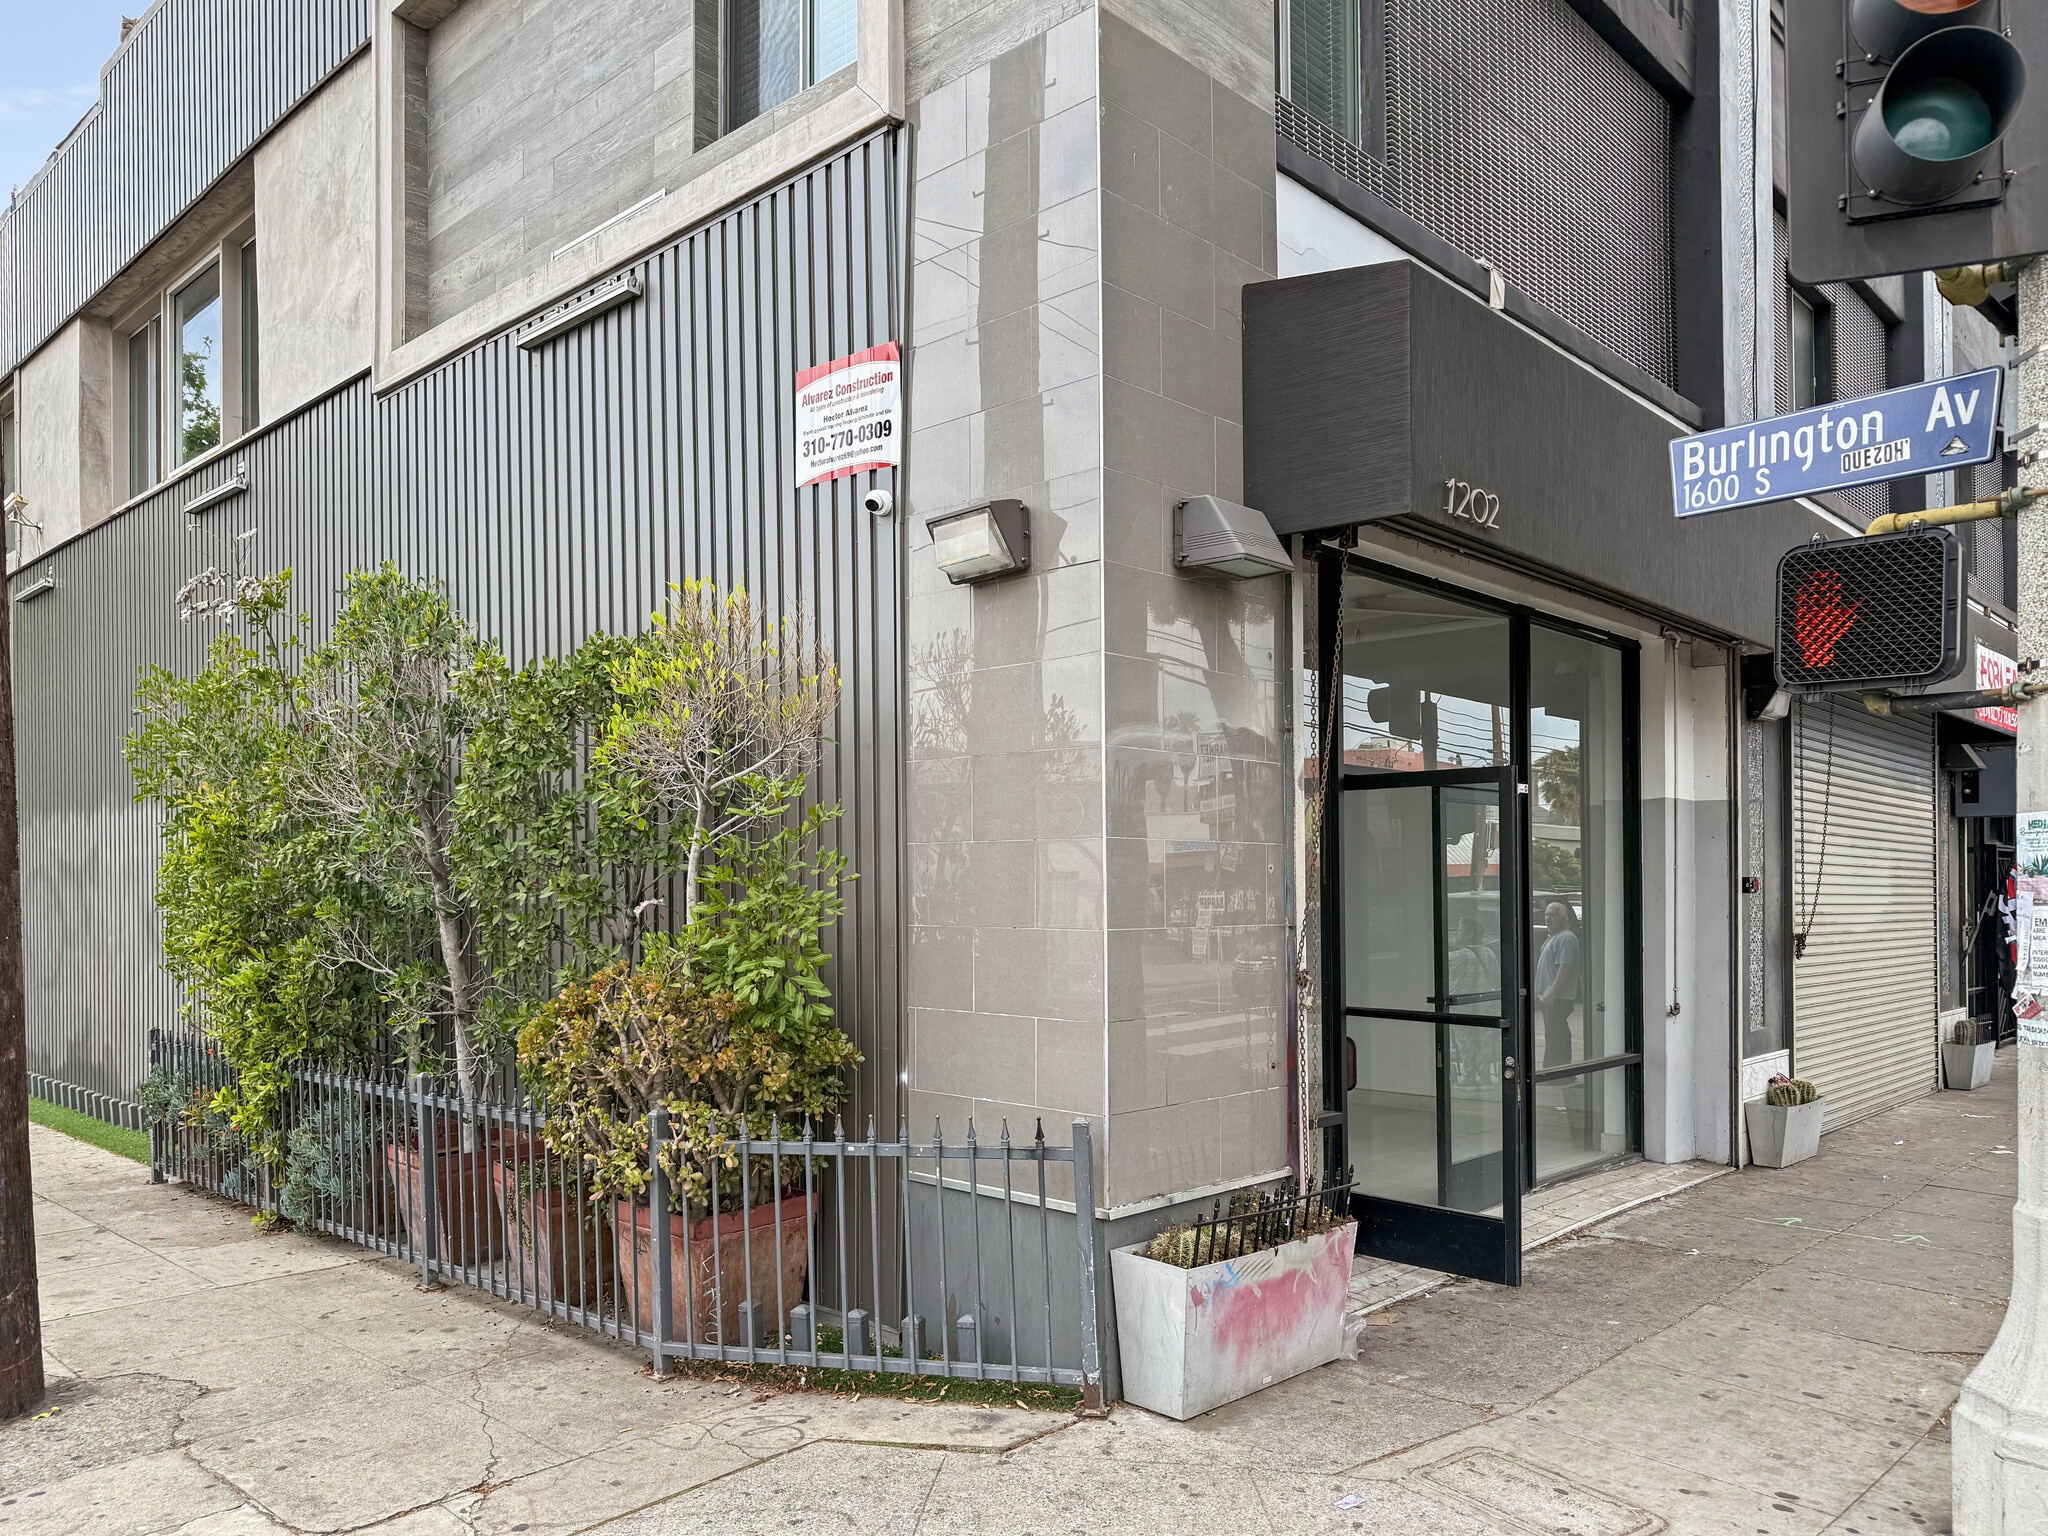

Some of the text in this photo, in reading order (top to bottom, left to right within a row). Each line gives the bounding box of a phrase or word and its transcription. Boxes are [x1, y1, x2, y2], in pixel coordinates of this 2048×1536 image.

[802, 371, 893, 407] Alvarez Construction
[823, 405, 868, 423] Hector Alvarez
[1683, 385, 1980, 482] Burlington Av
[803, 419, 892, 458] 310-770-0309
[1444, 478, 1500, 529] 1202
[1683, 467, 1770, 510] 1600 S
[1980, 655, 2000, 689] FOR
